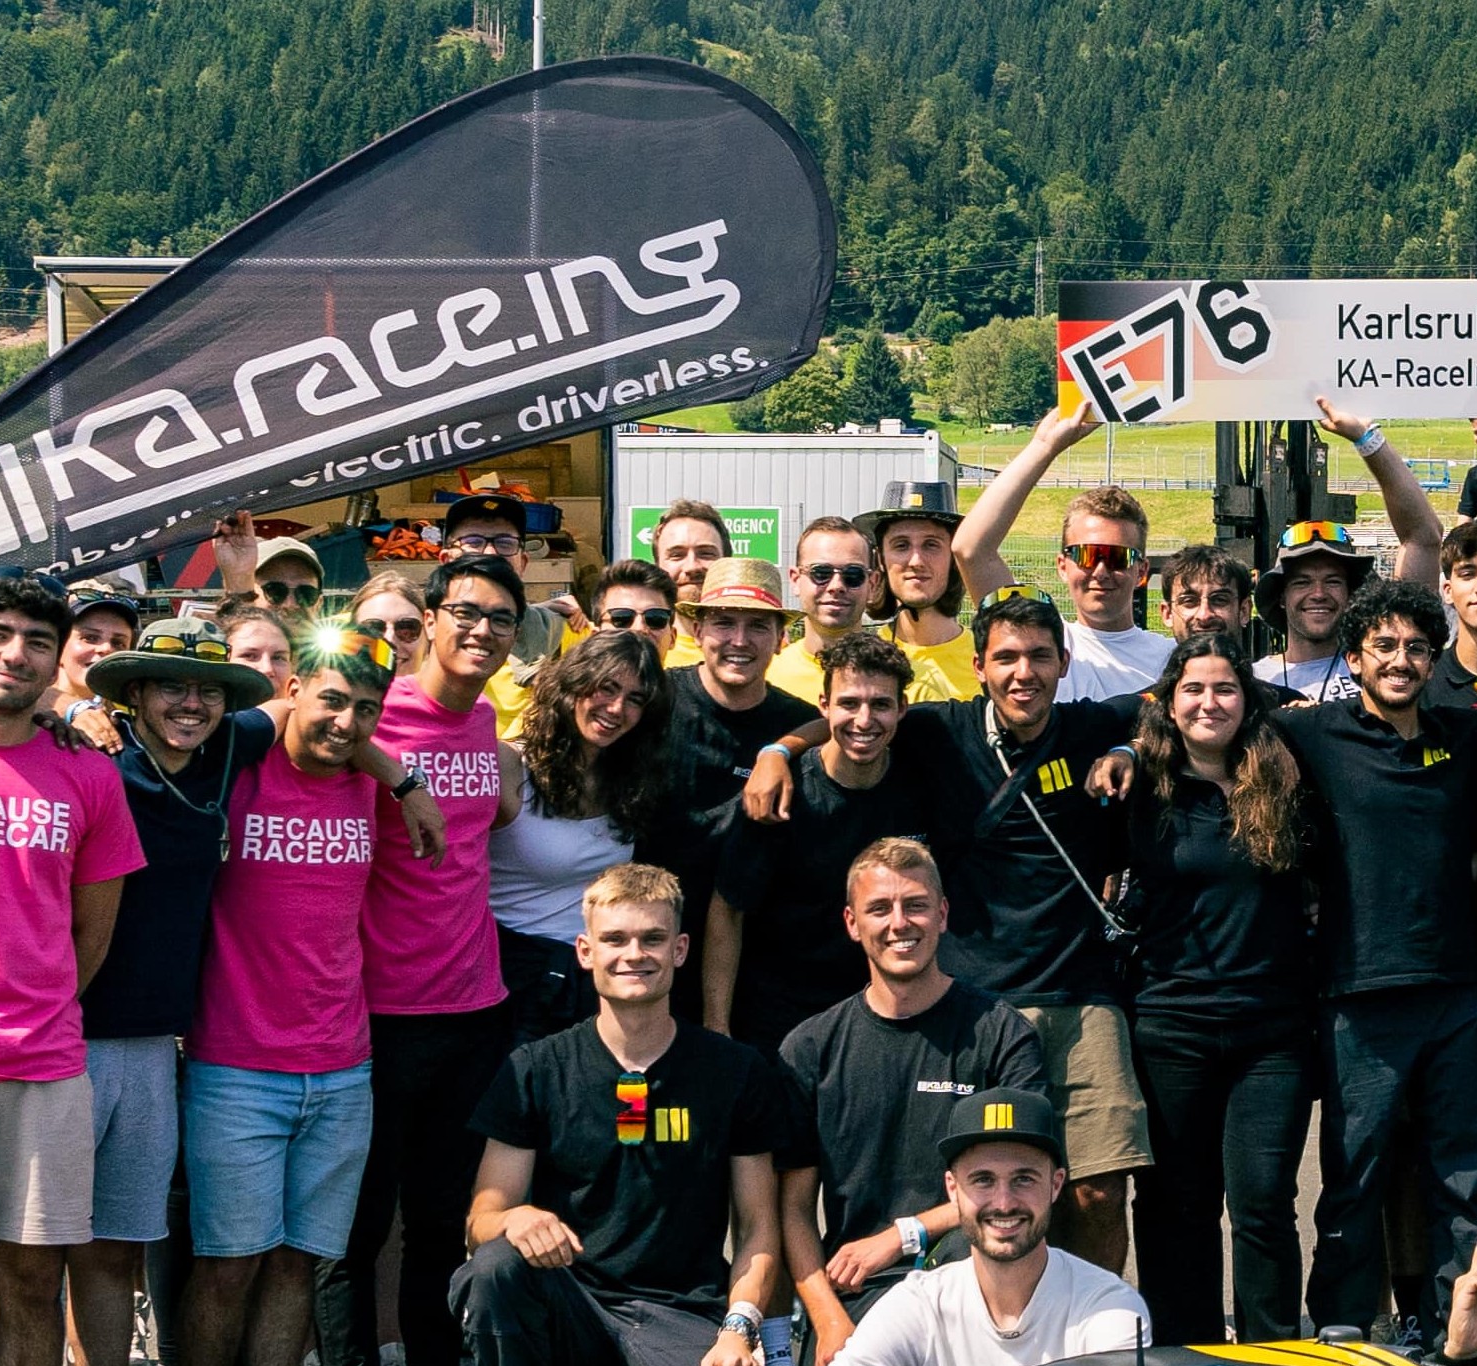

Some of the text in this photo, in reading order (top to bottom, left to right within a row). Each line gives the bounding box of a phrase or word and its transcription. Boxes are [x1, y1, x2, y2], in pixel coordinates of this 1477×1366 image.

[1072, 280, 1271, 422] E76
[518, 346, 770, 433] driverless.
[725, 518, 775, 534] RGENCY
[731, 539, 751, 555] XIT
[401, 751, 499, 775] BECAUSE
[424, 773, 501, 798] ACECAR
[244, 814, 370, 841] BECAUSE
